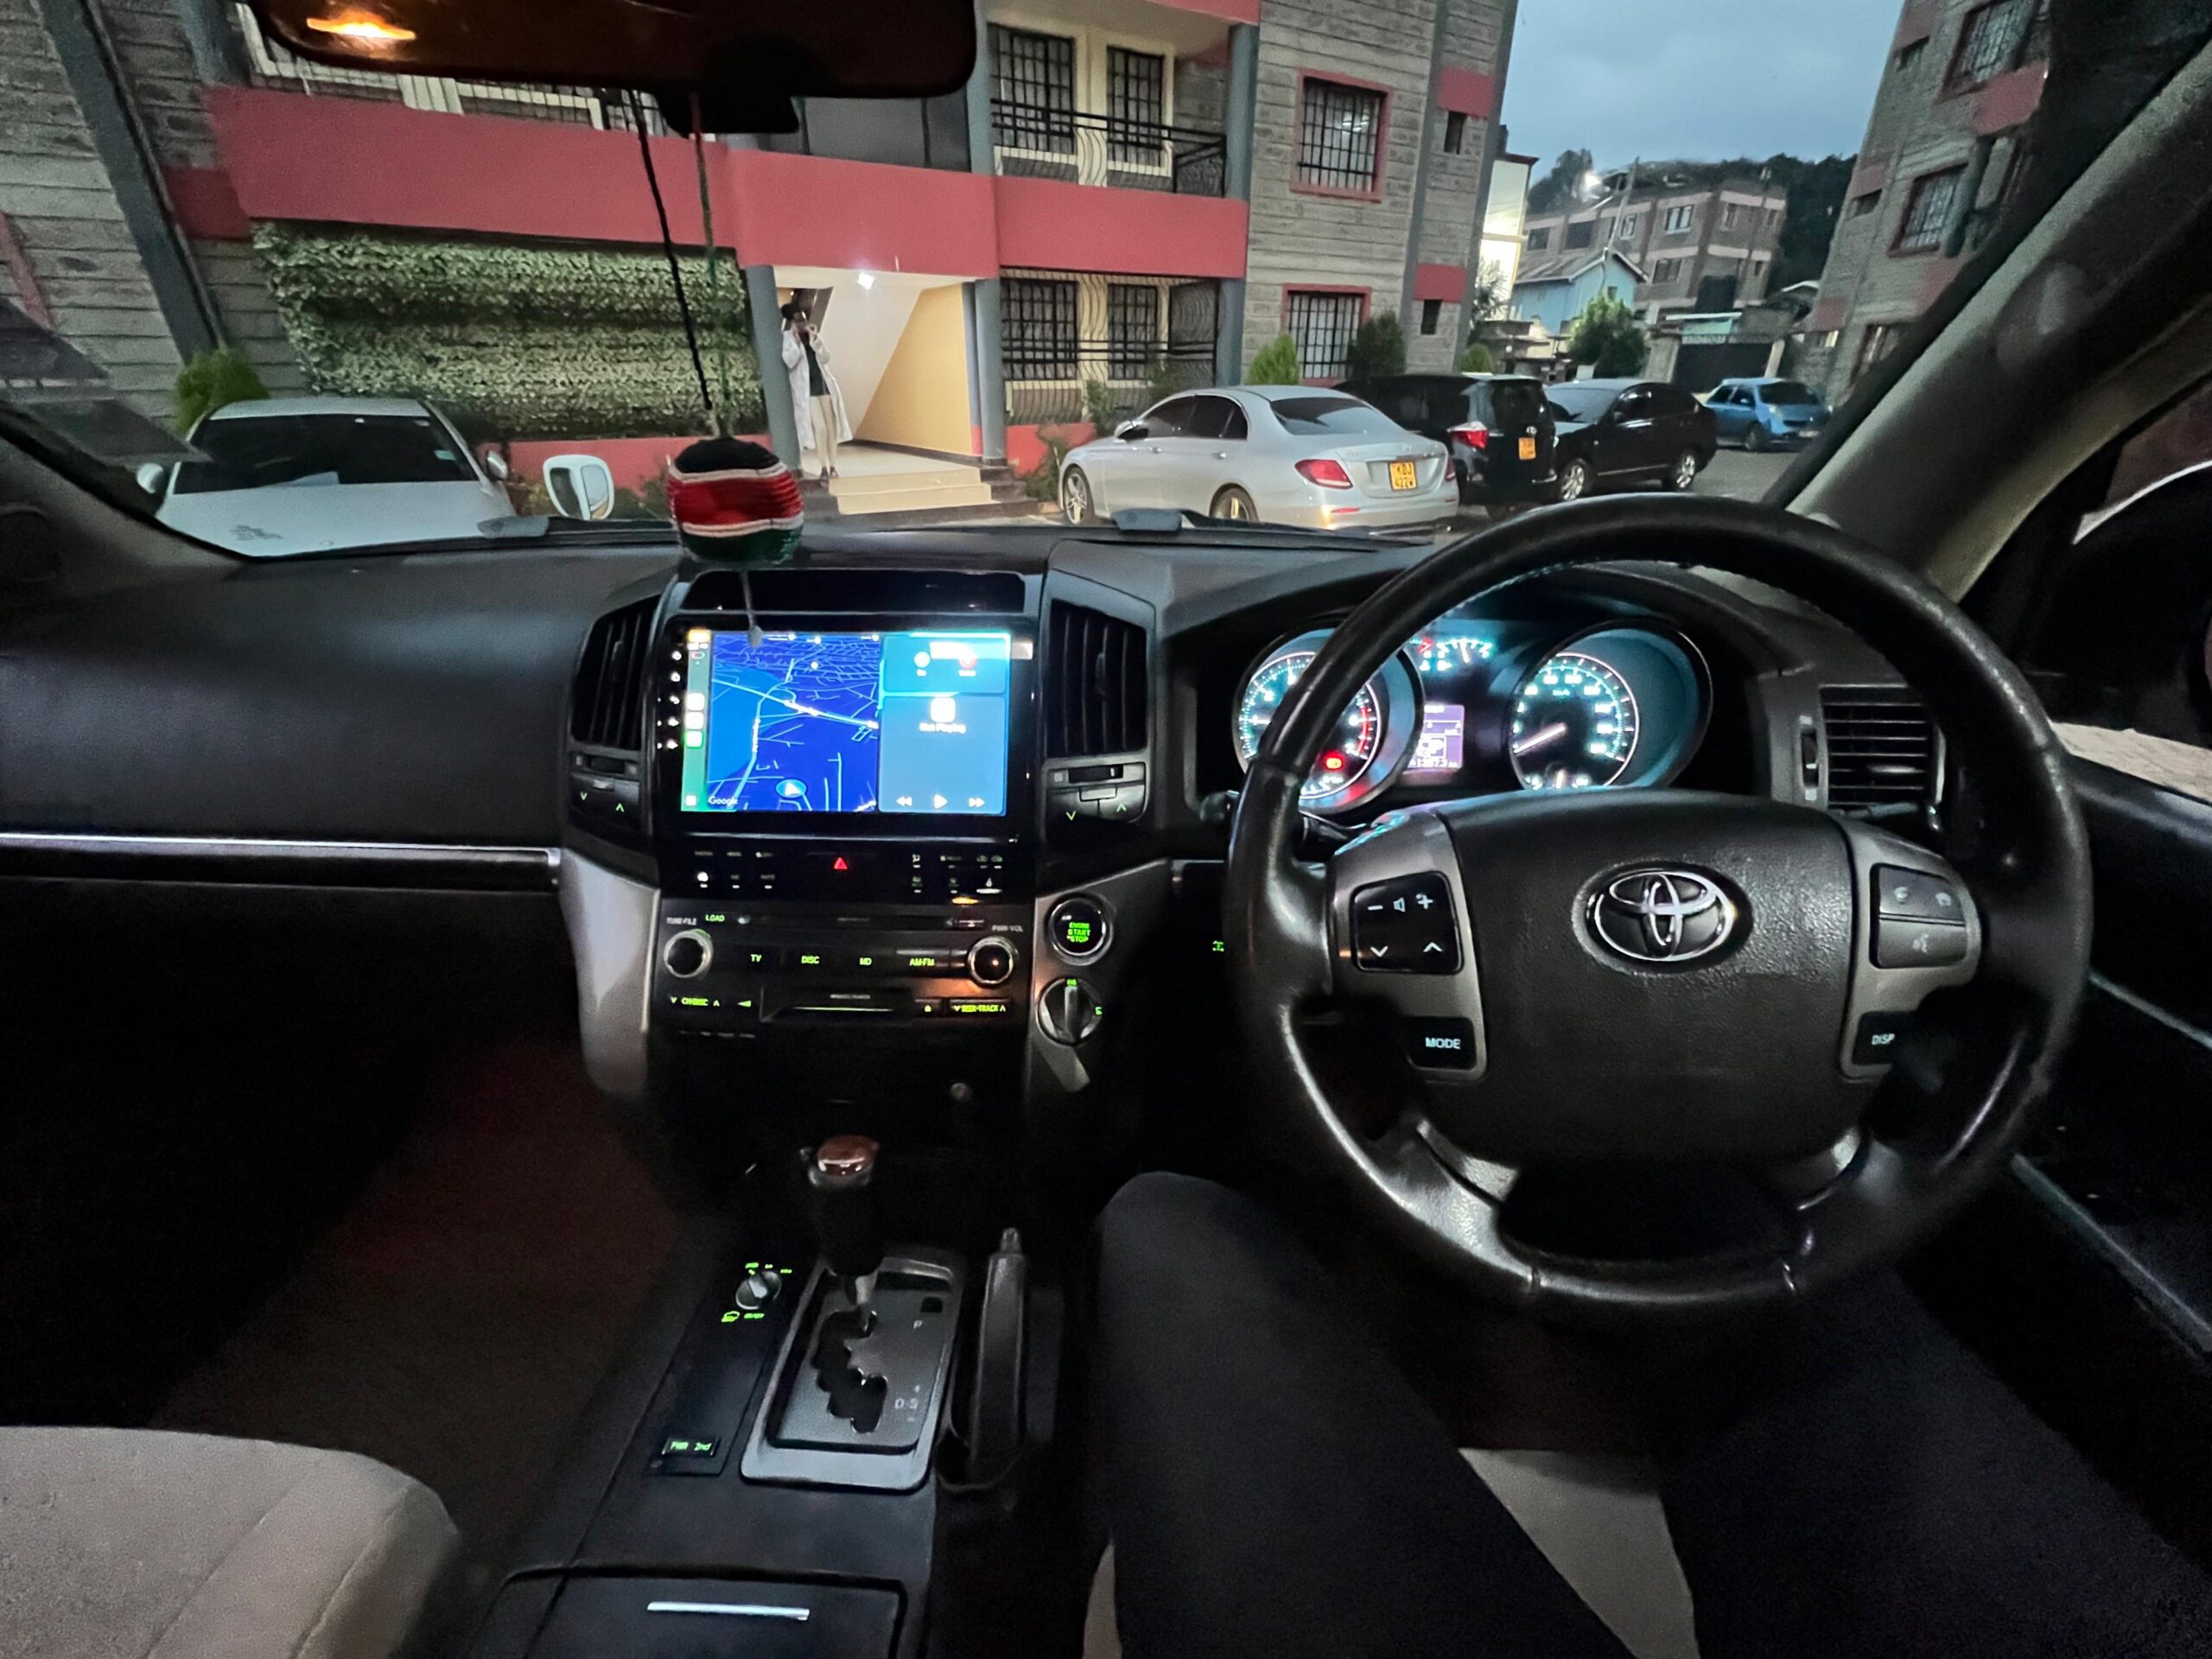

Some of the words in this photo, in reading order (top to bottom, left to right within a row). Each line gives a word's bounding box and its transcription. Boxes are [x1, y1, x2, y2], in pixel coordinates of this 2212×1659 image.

[708, 795, 738, 805] Google
[802, 956, 819, 964] DISC
[1426, 1038, 1460, 1049] MODE
[1872, 1033, 1895, 1045] DISP
[913, 1319, 922, 1329] P
